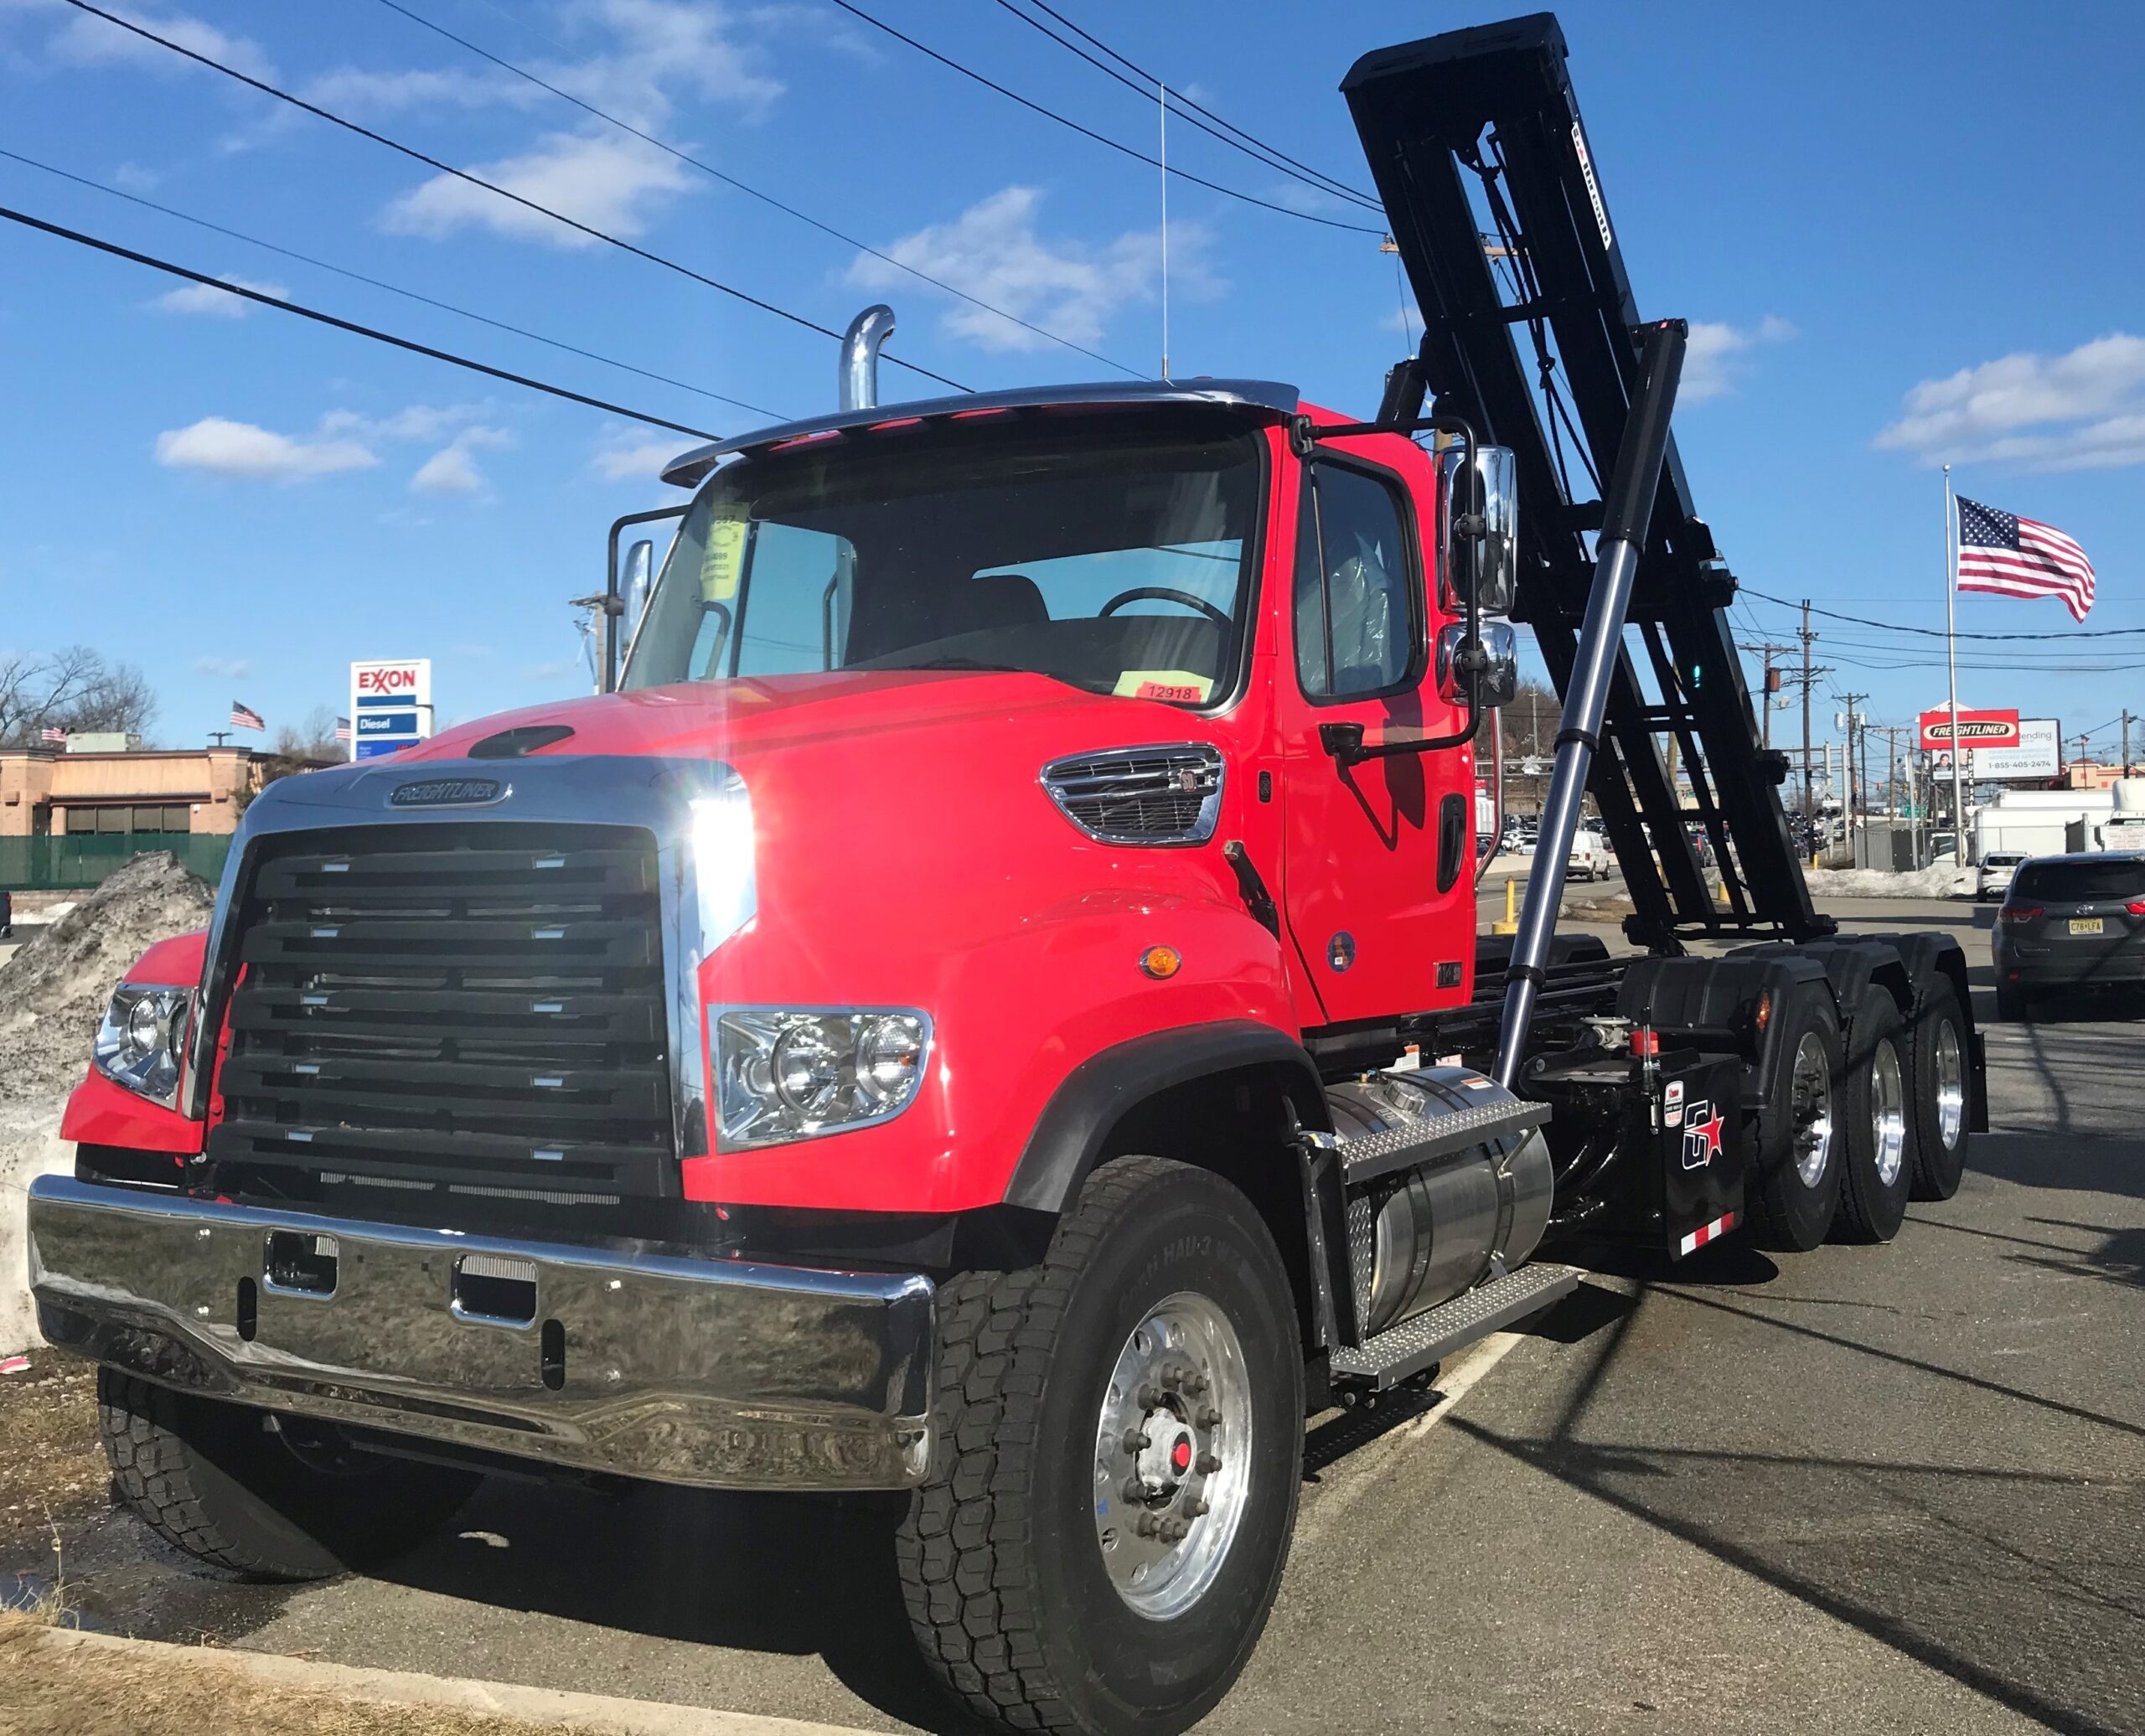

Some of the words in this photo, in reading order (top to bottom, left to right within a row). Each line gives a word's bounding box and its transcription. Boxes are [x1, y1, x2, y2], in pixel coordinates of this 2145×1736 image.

[358, 669, 416, 695] EXXON
[1148, 685, 1192, 700] 12918
[359, 718, 390, 730] Diesel
[1933, 725, 2007, 737] FREGHTLINER
[1988, 760, 2051, 769] 1-855-405-2474
[395, 783, 496, 802] FREIGHTLINER
